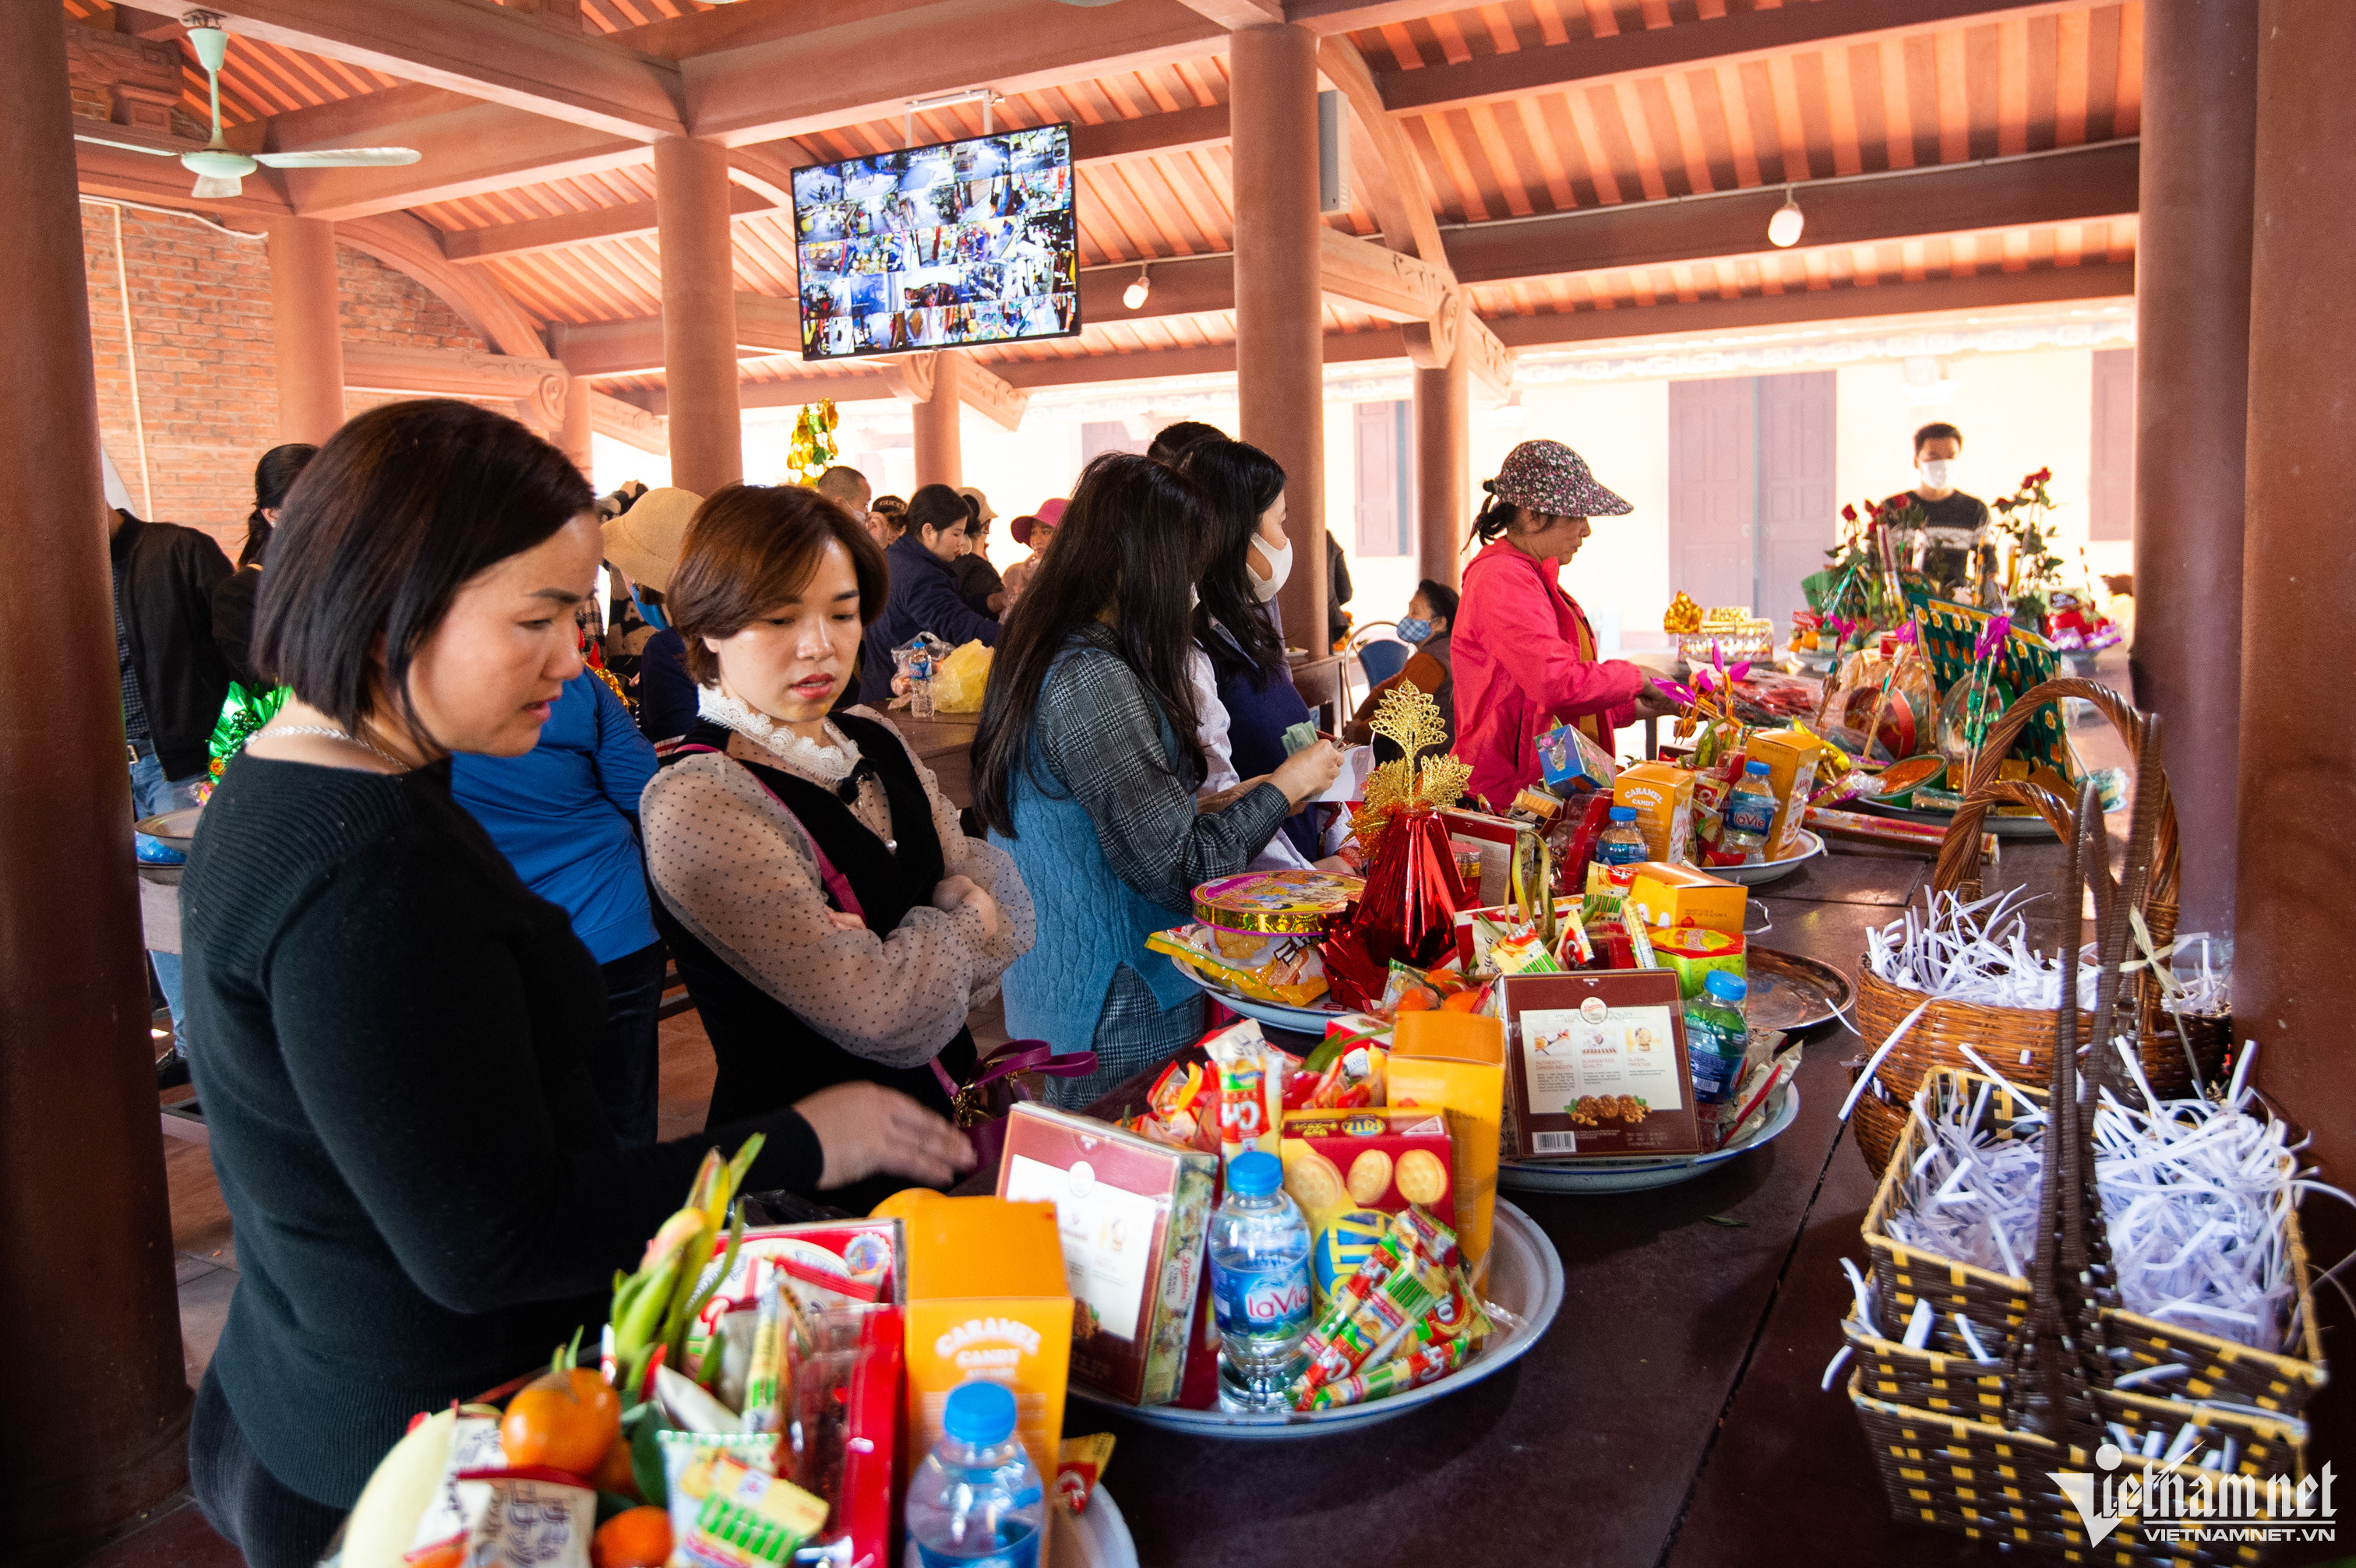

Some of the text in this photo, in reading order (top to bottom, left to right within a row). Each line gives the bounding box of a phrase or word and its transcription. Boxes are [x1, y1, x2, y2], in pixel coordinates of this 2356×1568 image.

[1624, 787, 1663, 804] CARAMEL
[1631, 798, 1656, 807] CANDY
[1733, 814, 1765, 828] laVie
[1344, 1118, 1384, 1134] RITZ
[1247, 1284, 1310, 1319] laVie
[936, 1317, 1042, 1358] CARAMEL
[956, 1348, 1021, 1367] CANDY
